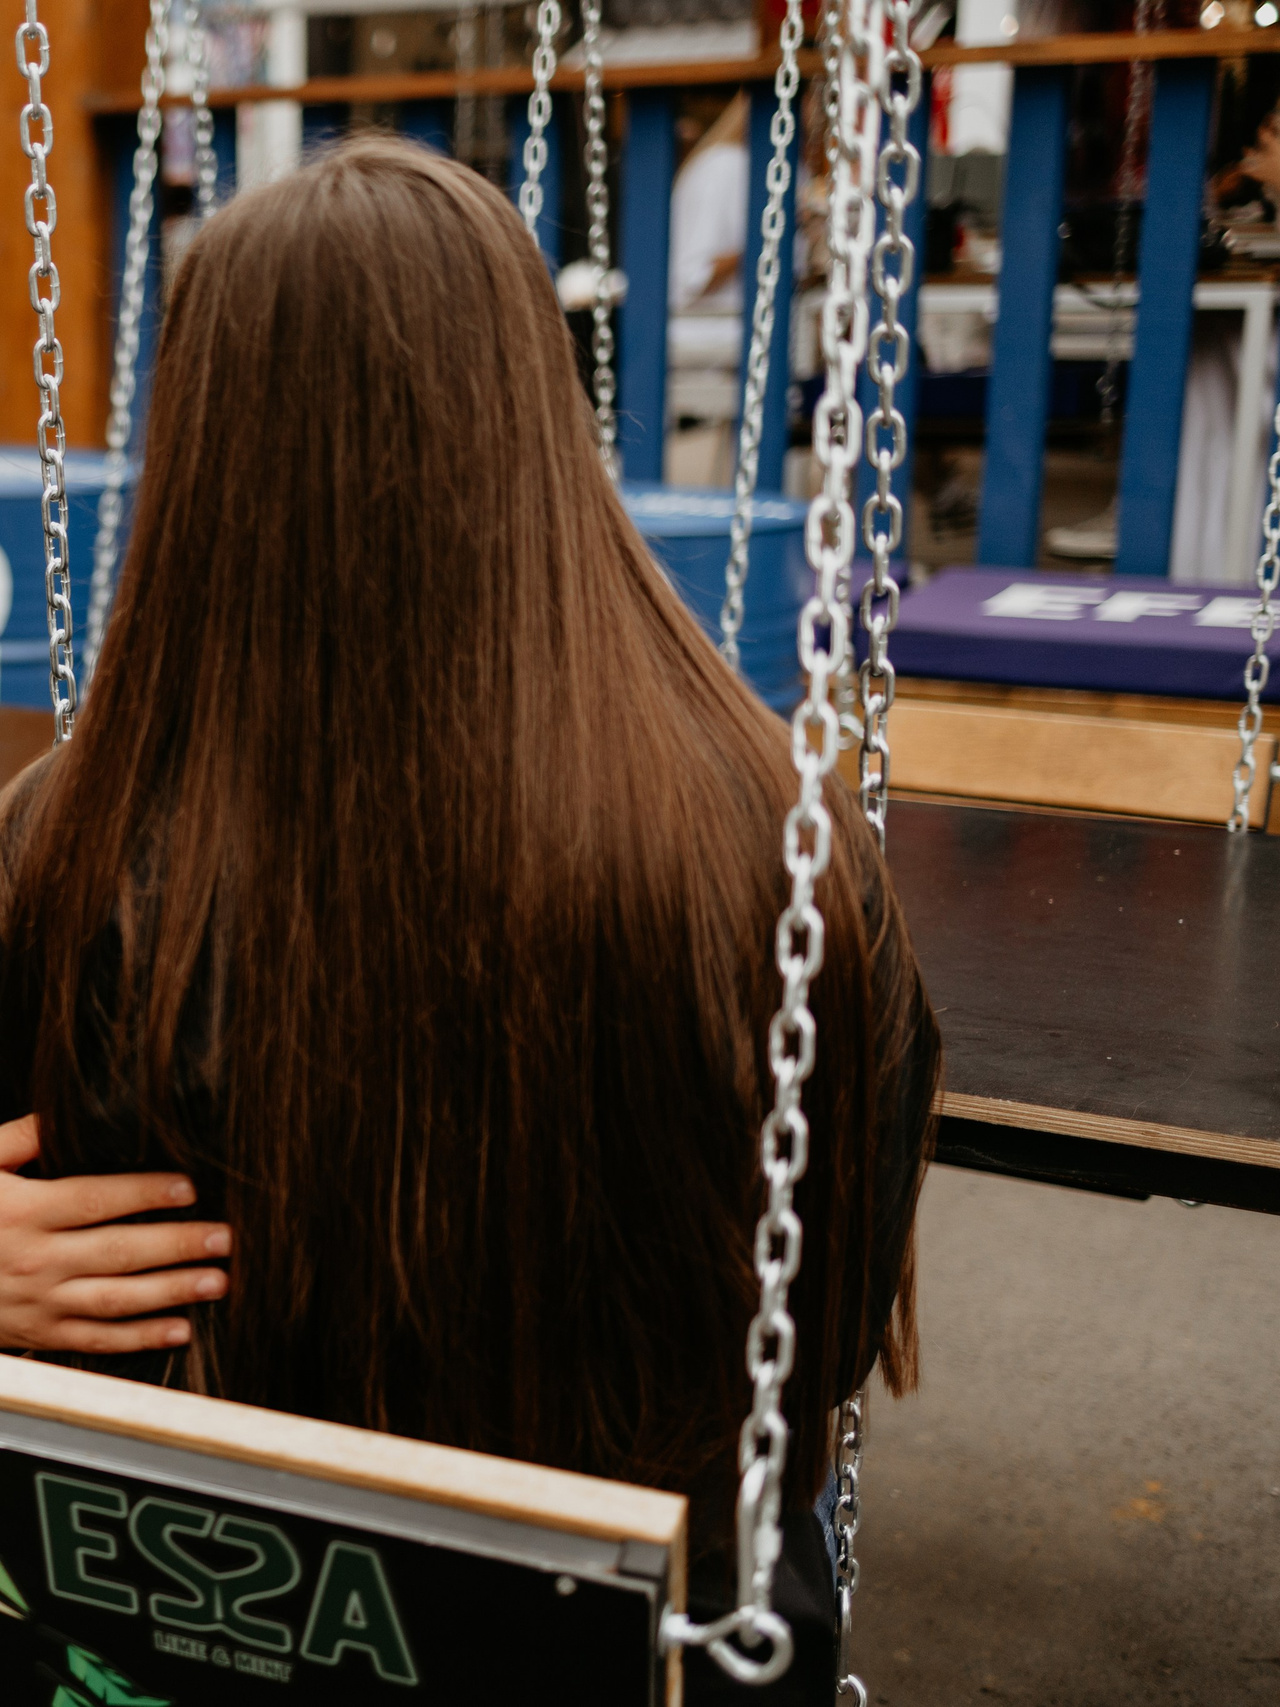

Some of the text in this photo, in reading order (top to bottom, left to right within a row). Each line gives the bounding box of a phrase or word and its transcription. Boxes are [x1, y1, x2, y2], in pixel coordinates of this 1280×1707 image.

[35, 1472, 418, 1686] ESSA
[154, 1630, 292, 1683] LIME & MINT
